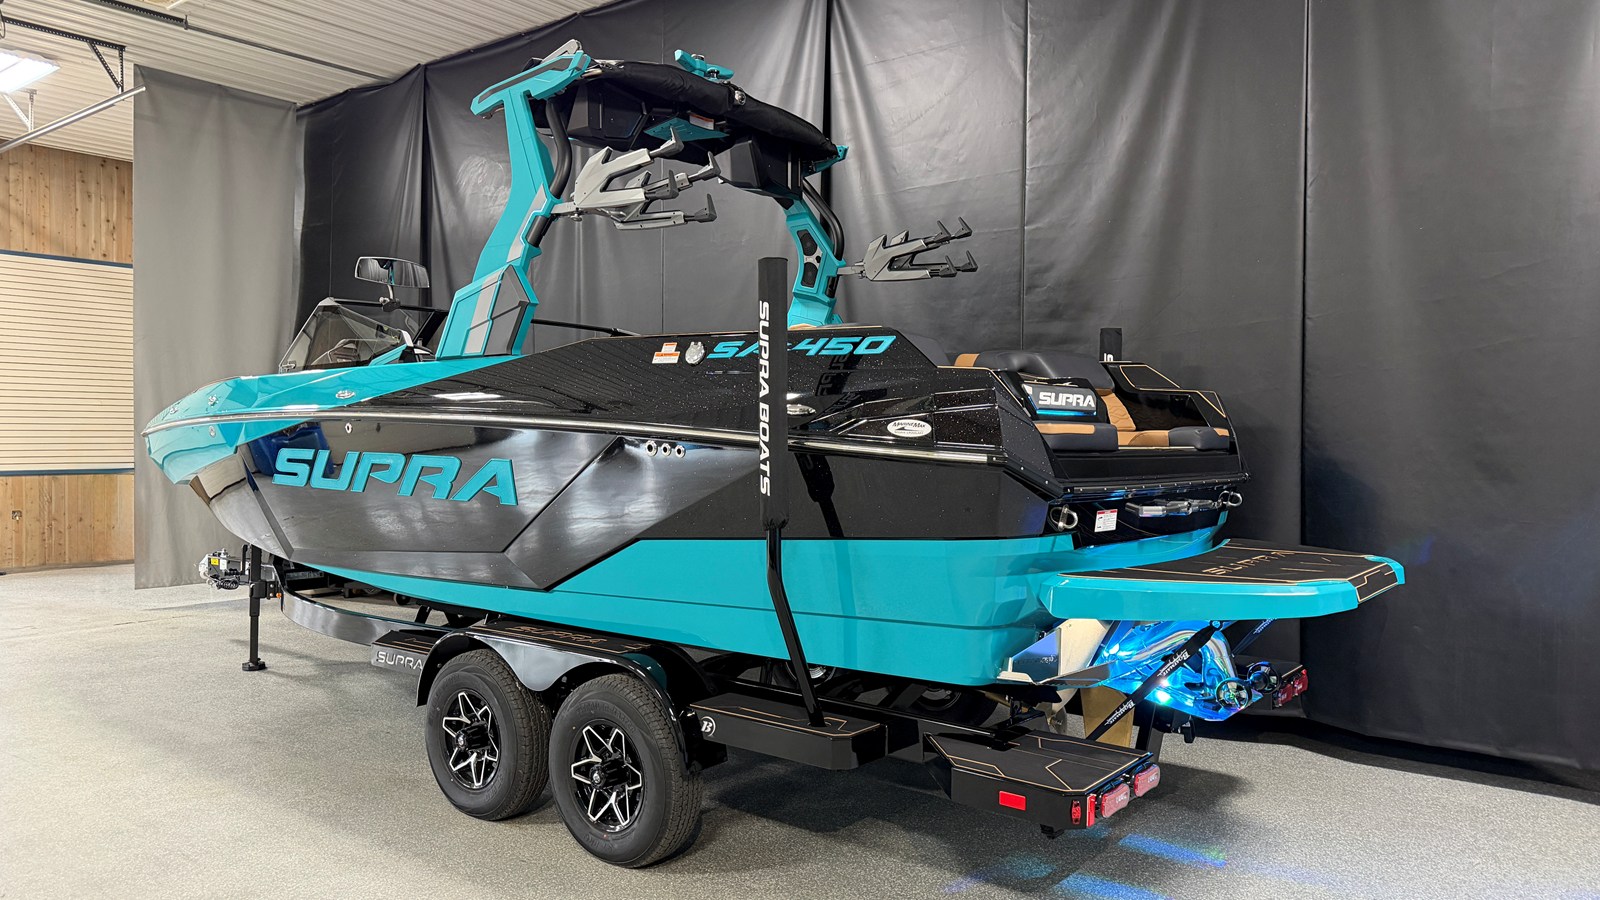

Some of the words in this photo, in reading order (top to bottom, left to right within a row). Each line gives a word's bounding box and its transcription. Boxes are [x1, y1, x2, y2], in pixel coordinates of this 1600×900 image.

[759, 300, 770, 398] SUPRA
[791, 335, 897, 356] 450
[1038, 391, 1096, 408] SUPRA
[759, 402, 771, 496] BOATS
[271, 447, 518, 506] SUPRA
[377, 651, 423, 670] SUPRA
